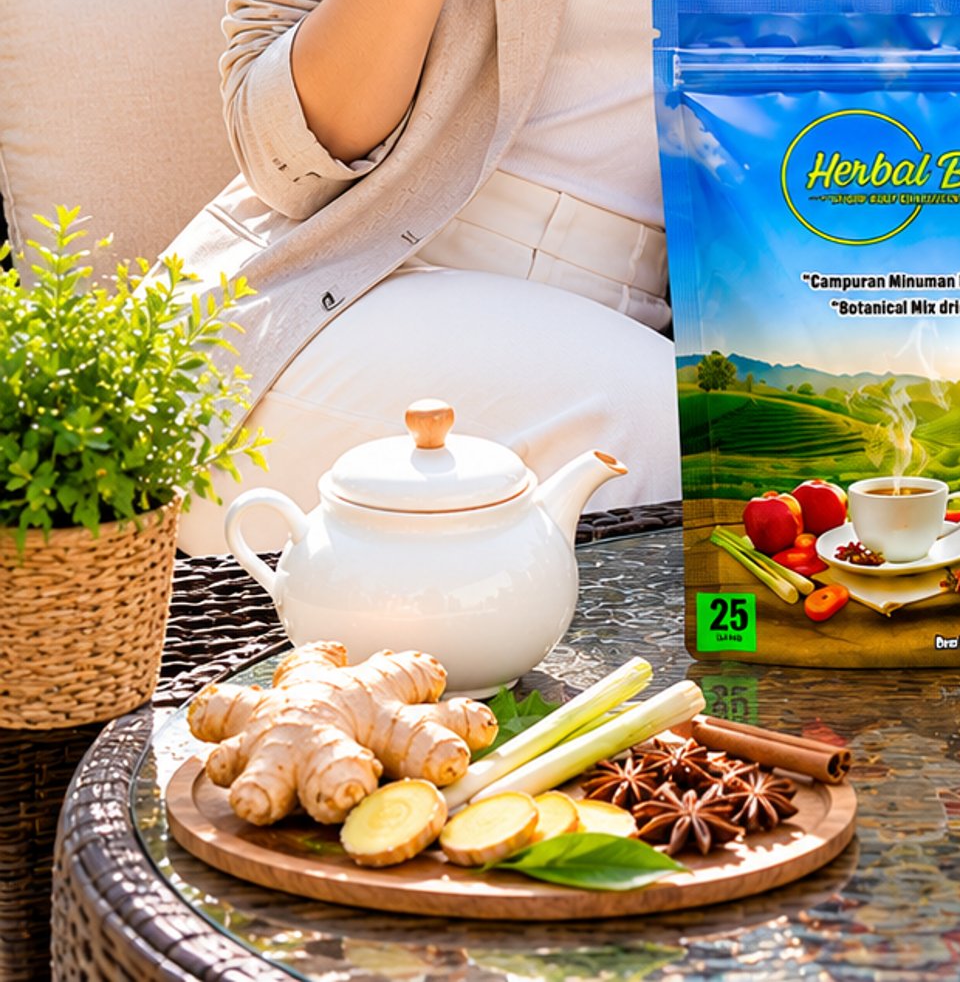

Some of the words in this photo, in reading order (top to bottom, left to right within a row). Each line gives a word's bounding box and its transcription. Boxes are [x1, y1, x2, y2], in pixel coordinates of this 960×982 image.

[805, 150, 931, 189] Herbal
[802, 273, 885, 291] "Campuran
[889, 274, 956, 288] Minuman
[831, 300, 907, 315] "Botanical
[911, 300, 936, 315] Mix
[710, 598, 749, 631] 25
